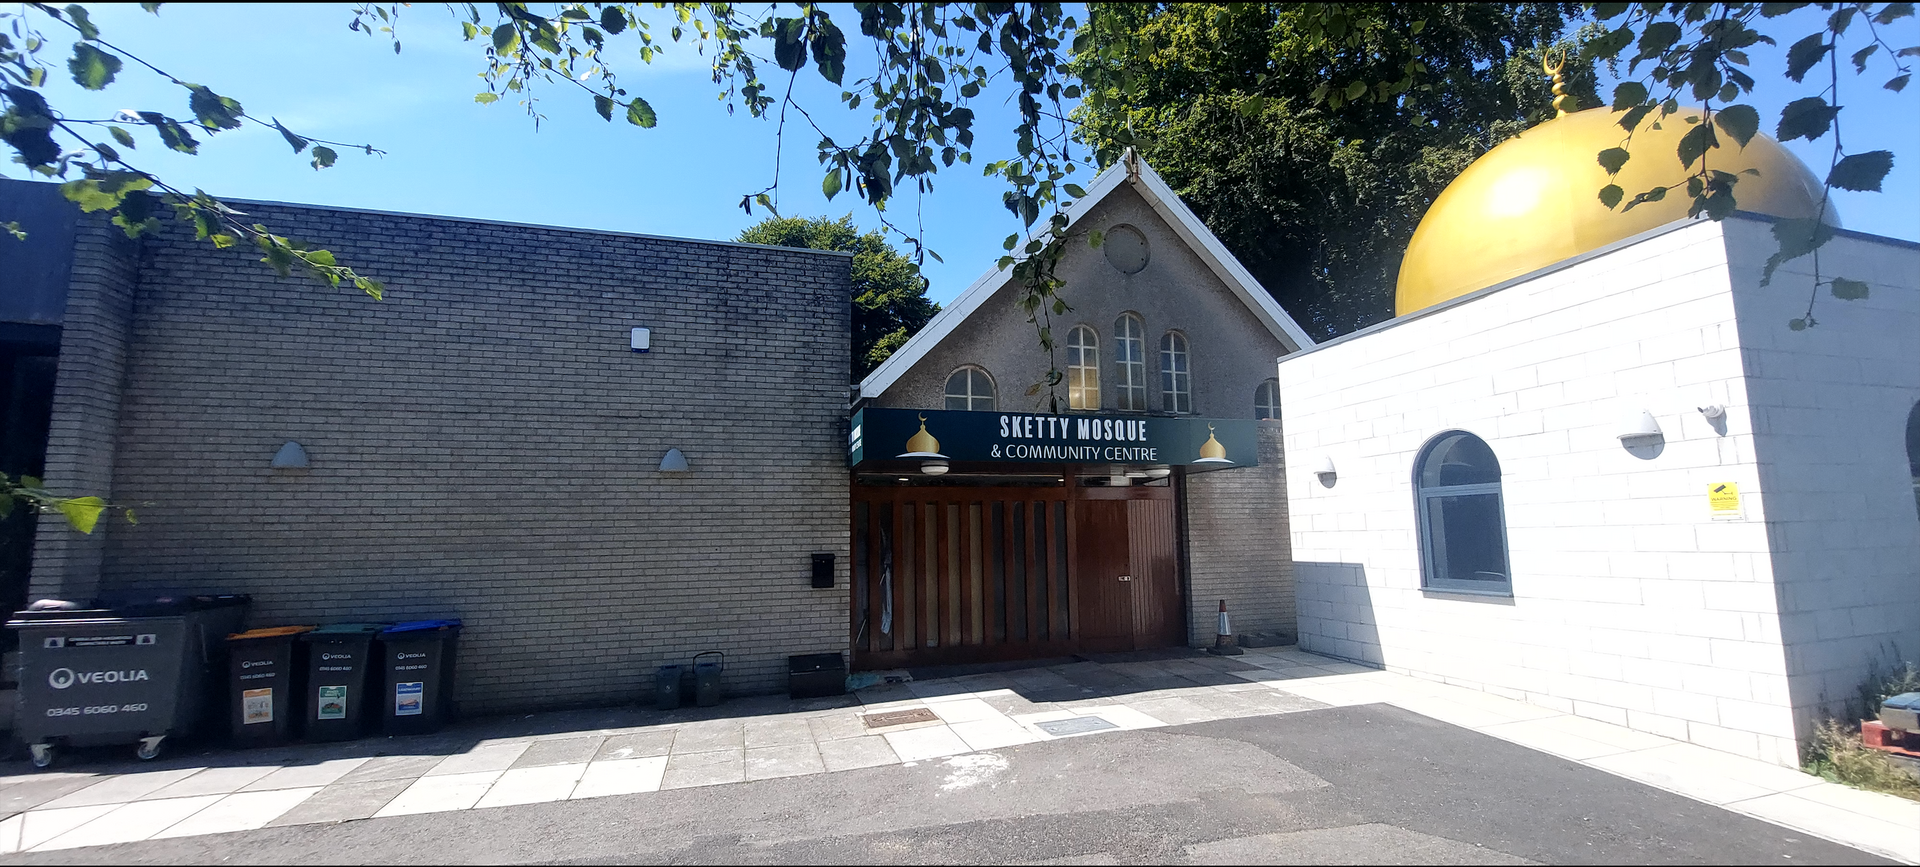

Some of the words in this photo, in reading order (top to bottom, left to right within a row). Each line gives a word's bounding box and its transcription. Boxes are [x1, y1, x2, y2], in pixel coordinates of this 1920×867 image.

[1000, 415, 1070, 440] SKETTY
[1077, 418, 1147, 442] MOSQUE
[991, 444, 1001, 458] &
[1005, 444, 1101, 460] COMMUNITY
[1104, 447, 1158, 461] CENTRE
[78, 670, 149, 684] VEOLIA
[46, 707, 80, 717] 0345
[83, 705, 118, 715] 6060
[121, 703, 148, 712] 460
